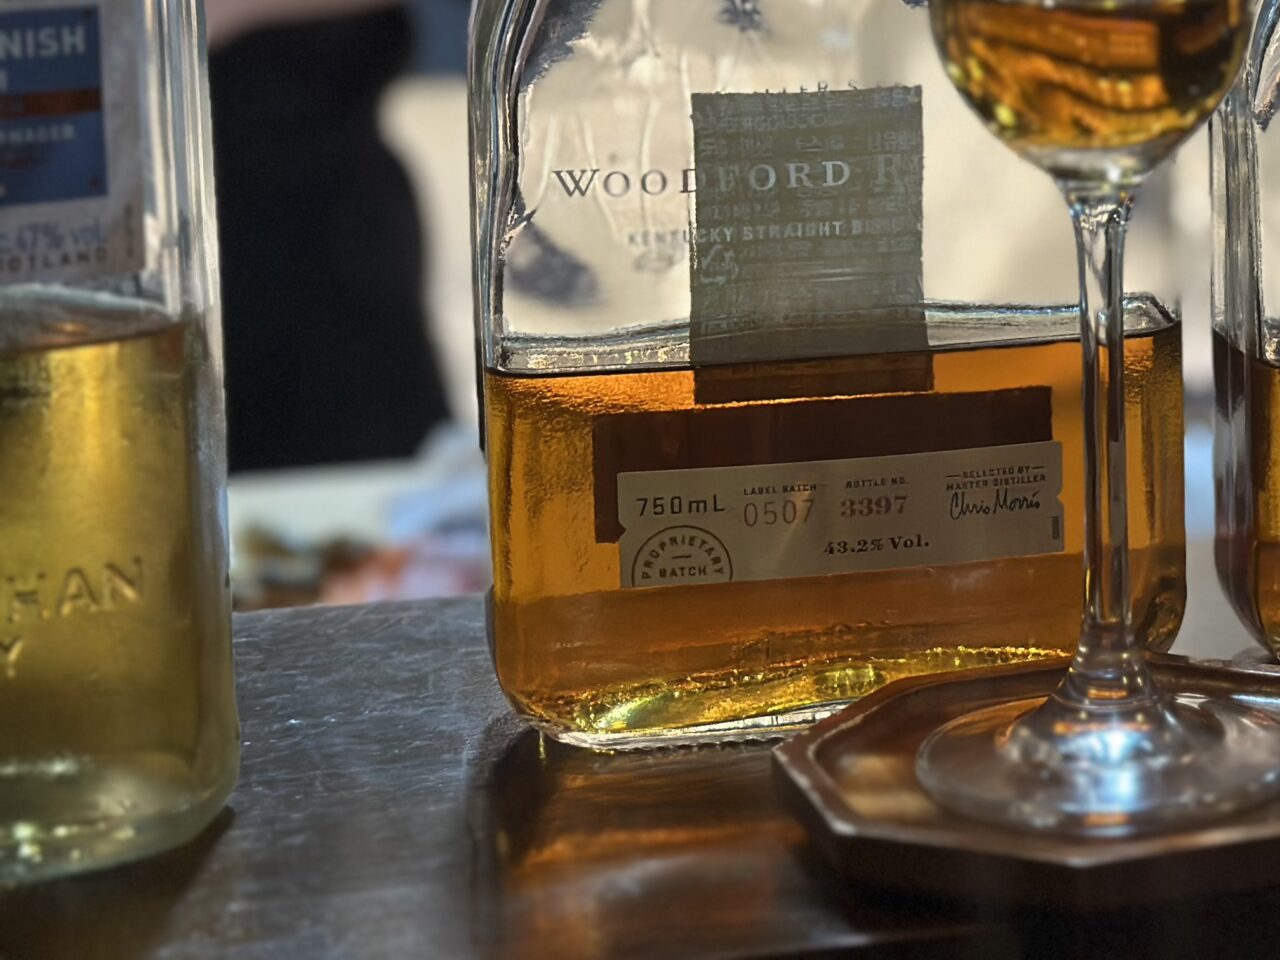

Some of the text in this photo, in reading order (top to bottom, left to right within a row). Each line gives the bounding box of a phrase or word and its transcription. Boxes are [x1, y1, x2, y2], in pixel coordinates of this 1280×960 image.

[0, 23, 86, 61] NISH
[552, 159, 851, 199] WOODFORD
[743, 220, 843, 242] STRAIGHT
[845, 478, 886, 489] BOTTLE
[946, 475, 1046, 492] MASTER DISTILLER
[962, 466, 1031, 479] SELECTED BY
[743, 483, 817, 497] LABEL BATCH
[636, 493, 725, 517] 750mL
[743, 498, 815, 527] 0507
[839, 494, 908, 519] 3397
[823, 533, 930, 556] 43.2% Vol.
[641, 533, 724, 581] PROPRIETARY
[658, 565, 708, 579] BATCH
[7, 555, 146, 623] HAN
